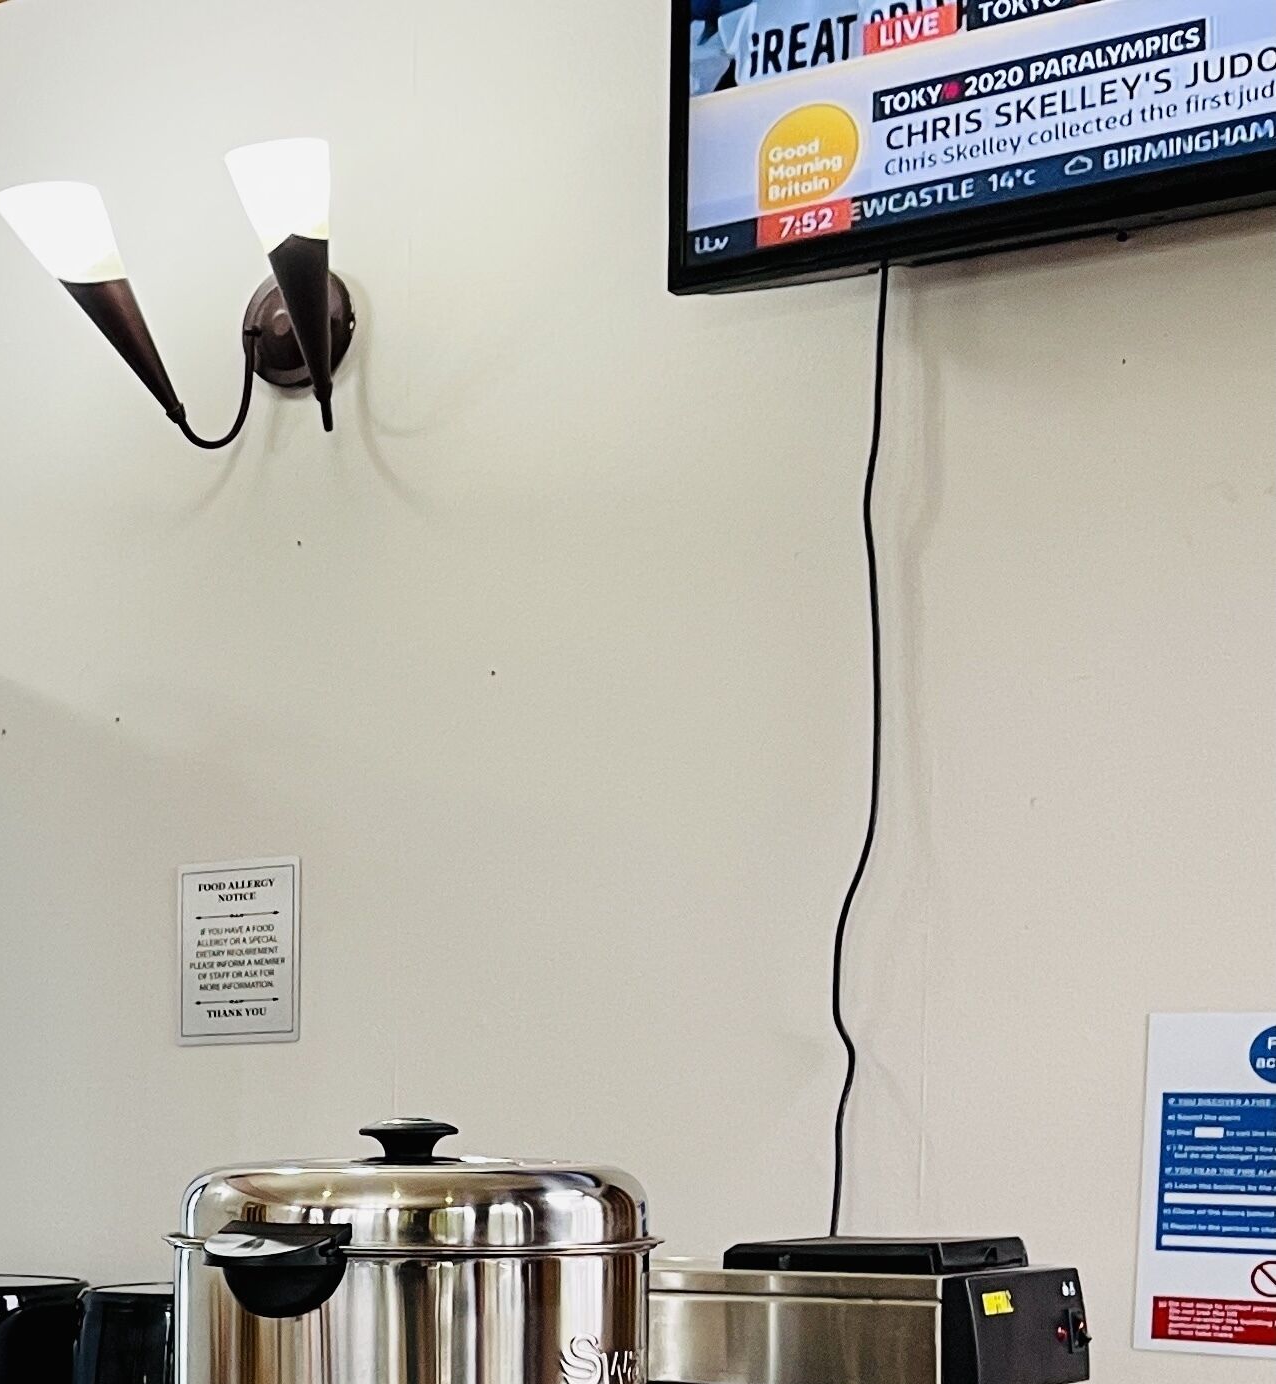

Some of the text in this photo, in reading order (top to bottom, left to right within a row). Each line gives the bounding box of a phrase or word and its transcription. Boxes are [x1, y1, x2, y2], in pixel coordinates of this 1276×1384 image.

[879, 11, 940, 47] LIVE
[964, 66, 1024, 97] 2020
[1029, 27, 1201, 83] PARALYMPICS
[886, 46, 1276, 150] CHRIS SKELLEY'S JUDO
[885, 147, 937, 177] Chris
[943, 136, 1022, 164] Skelley
[1028, 109, 1133, 147] collected
[1140, 103, 1178, 123] the
[1185, 89, 1231, 115] first
[1103, 118, 1275, 170] BIRMINGHAM
[769, 138, 821, 162] Good
[768, 154, 843, 183] Morning
[768, 175, 830, 201] Britain
[779, 207, 834, 239] 7:52
[198, 878, 276, 892] FOOD ALLERGY
[217, 891, 257, 902] NOTICE
[224, 925, 244, 934] HAVE
[252, 924, 275, 933] FOOD
[206, 1007, 267, 1019] THANK YOU
